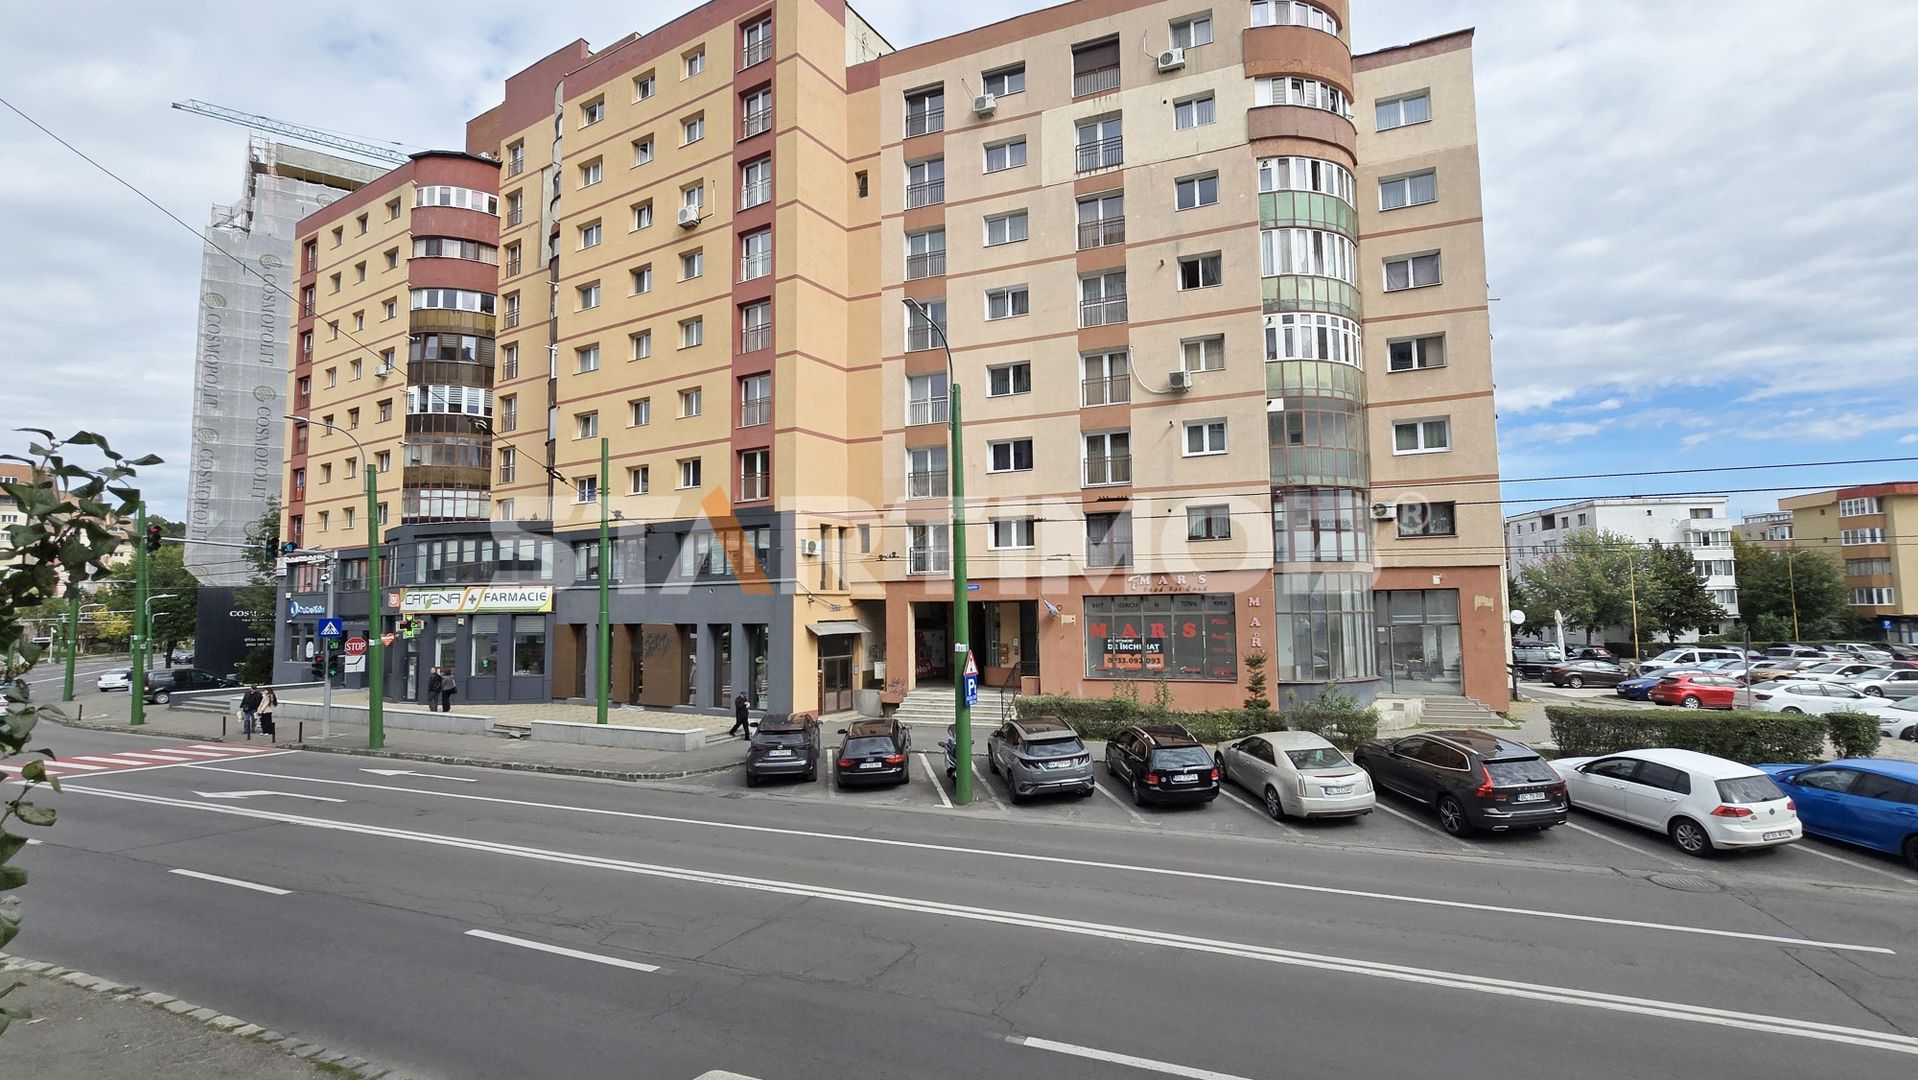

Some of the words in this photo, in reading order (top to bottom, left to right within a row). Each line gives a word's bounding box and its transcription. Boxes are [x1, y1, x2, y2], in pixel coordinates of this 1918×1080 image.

[260, 273, 277, 367] COSMOPOLIT
[203, 313, 221, 409] COSMOPOLIT
[251, 406, 271, 501] COSMOPOLIT
[405, 593, 461, 605] CATENA
[484, 592, 547, 602] FARMACIE
[345, 642, 366, 650] STOP
[1119, 640, 1160, 651] ÎNCHIIAT
